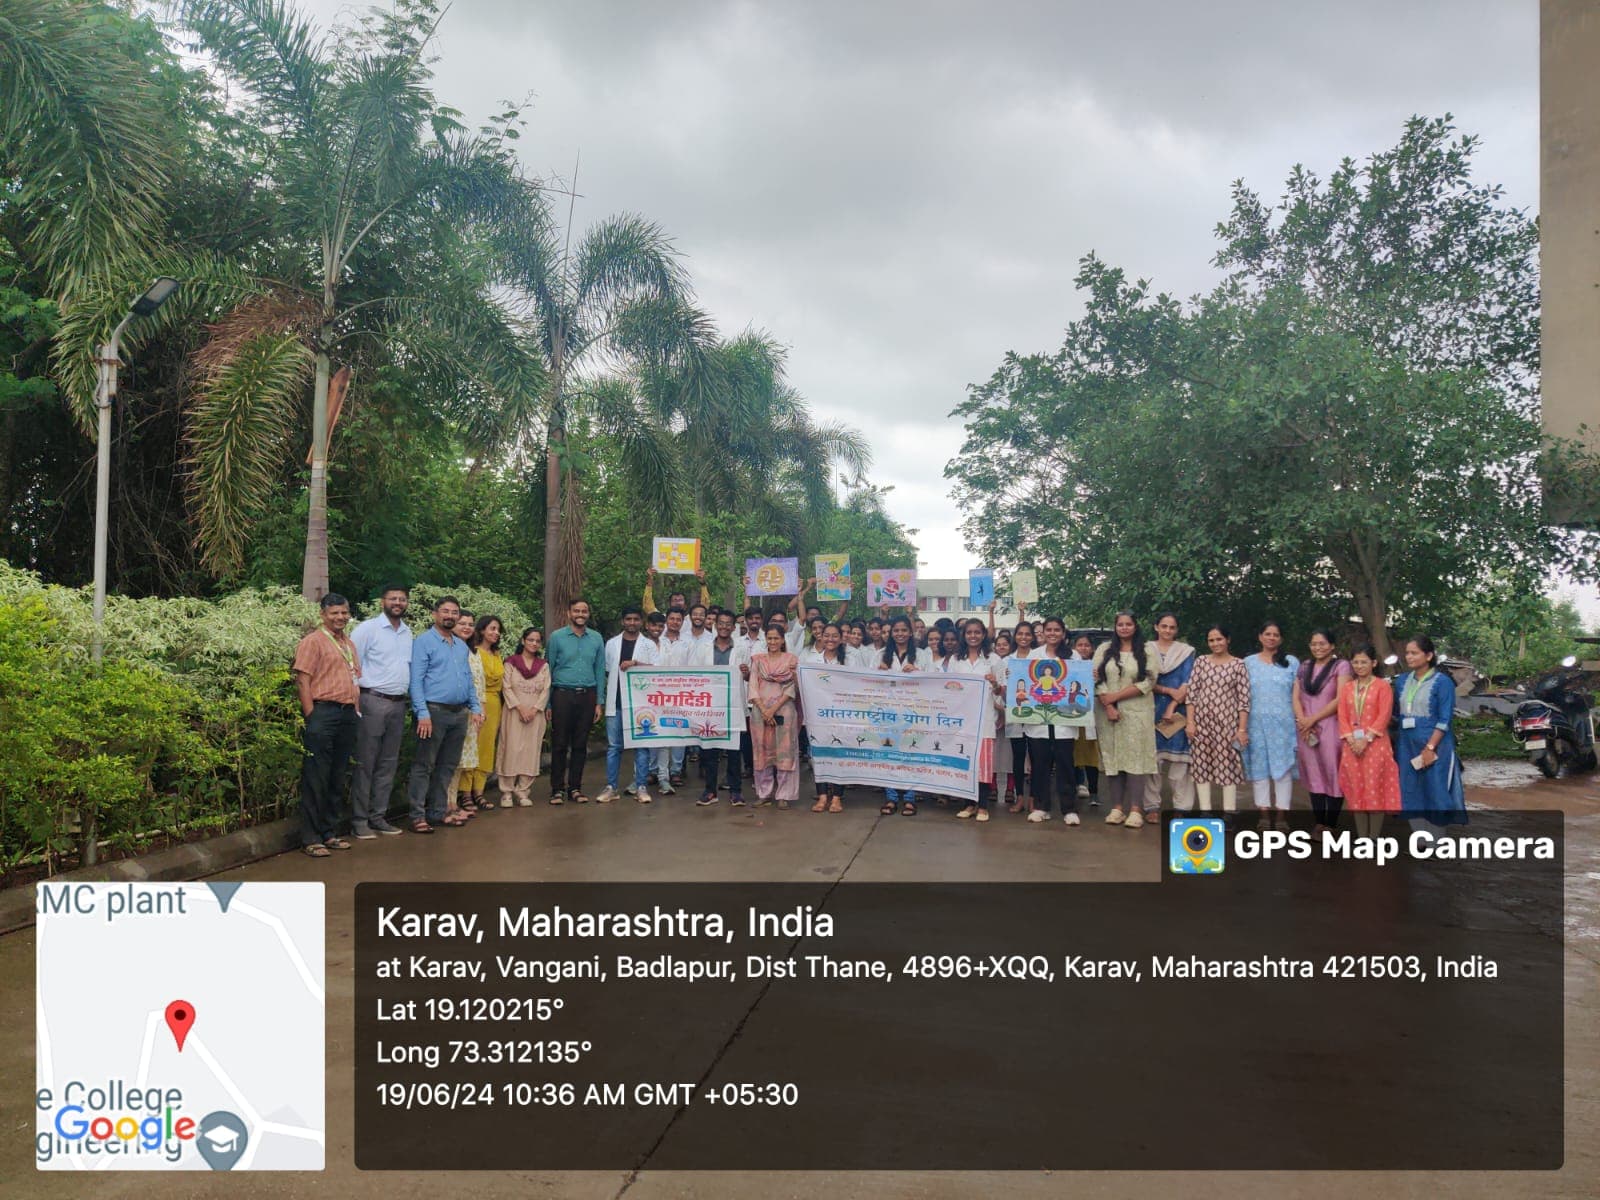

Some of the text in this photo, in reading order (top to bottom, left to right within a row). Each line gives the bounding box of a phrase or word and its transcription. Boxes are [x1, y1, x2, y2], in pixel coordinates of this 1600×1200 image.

[646, 690, 713, 708] योगदिंडी
[817, 704, 898, 725] आंतरराष्ट्रीय
[902, 710, 931, 727] योग
[936, 712, 965, 729] दिन
